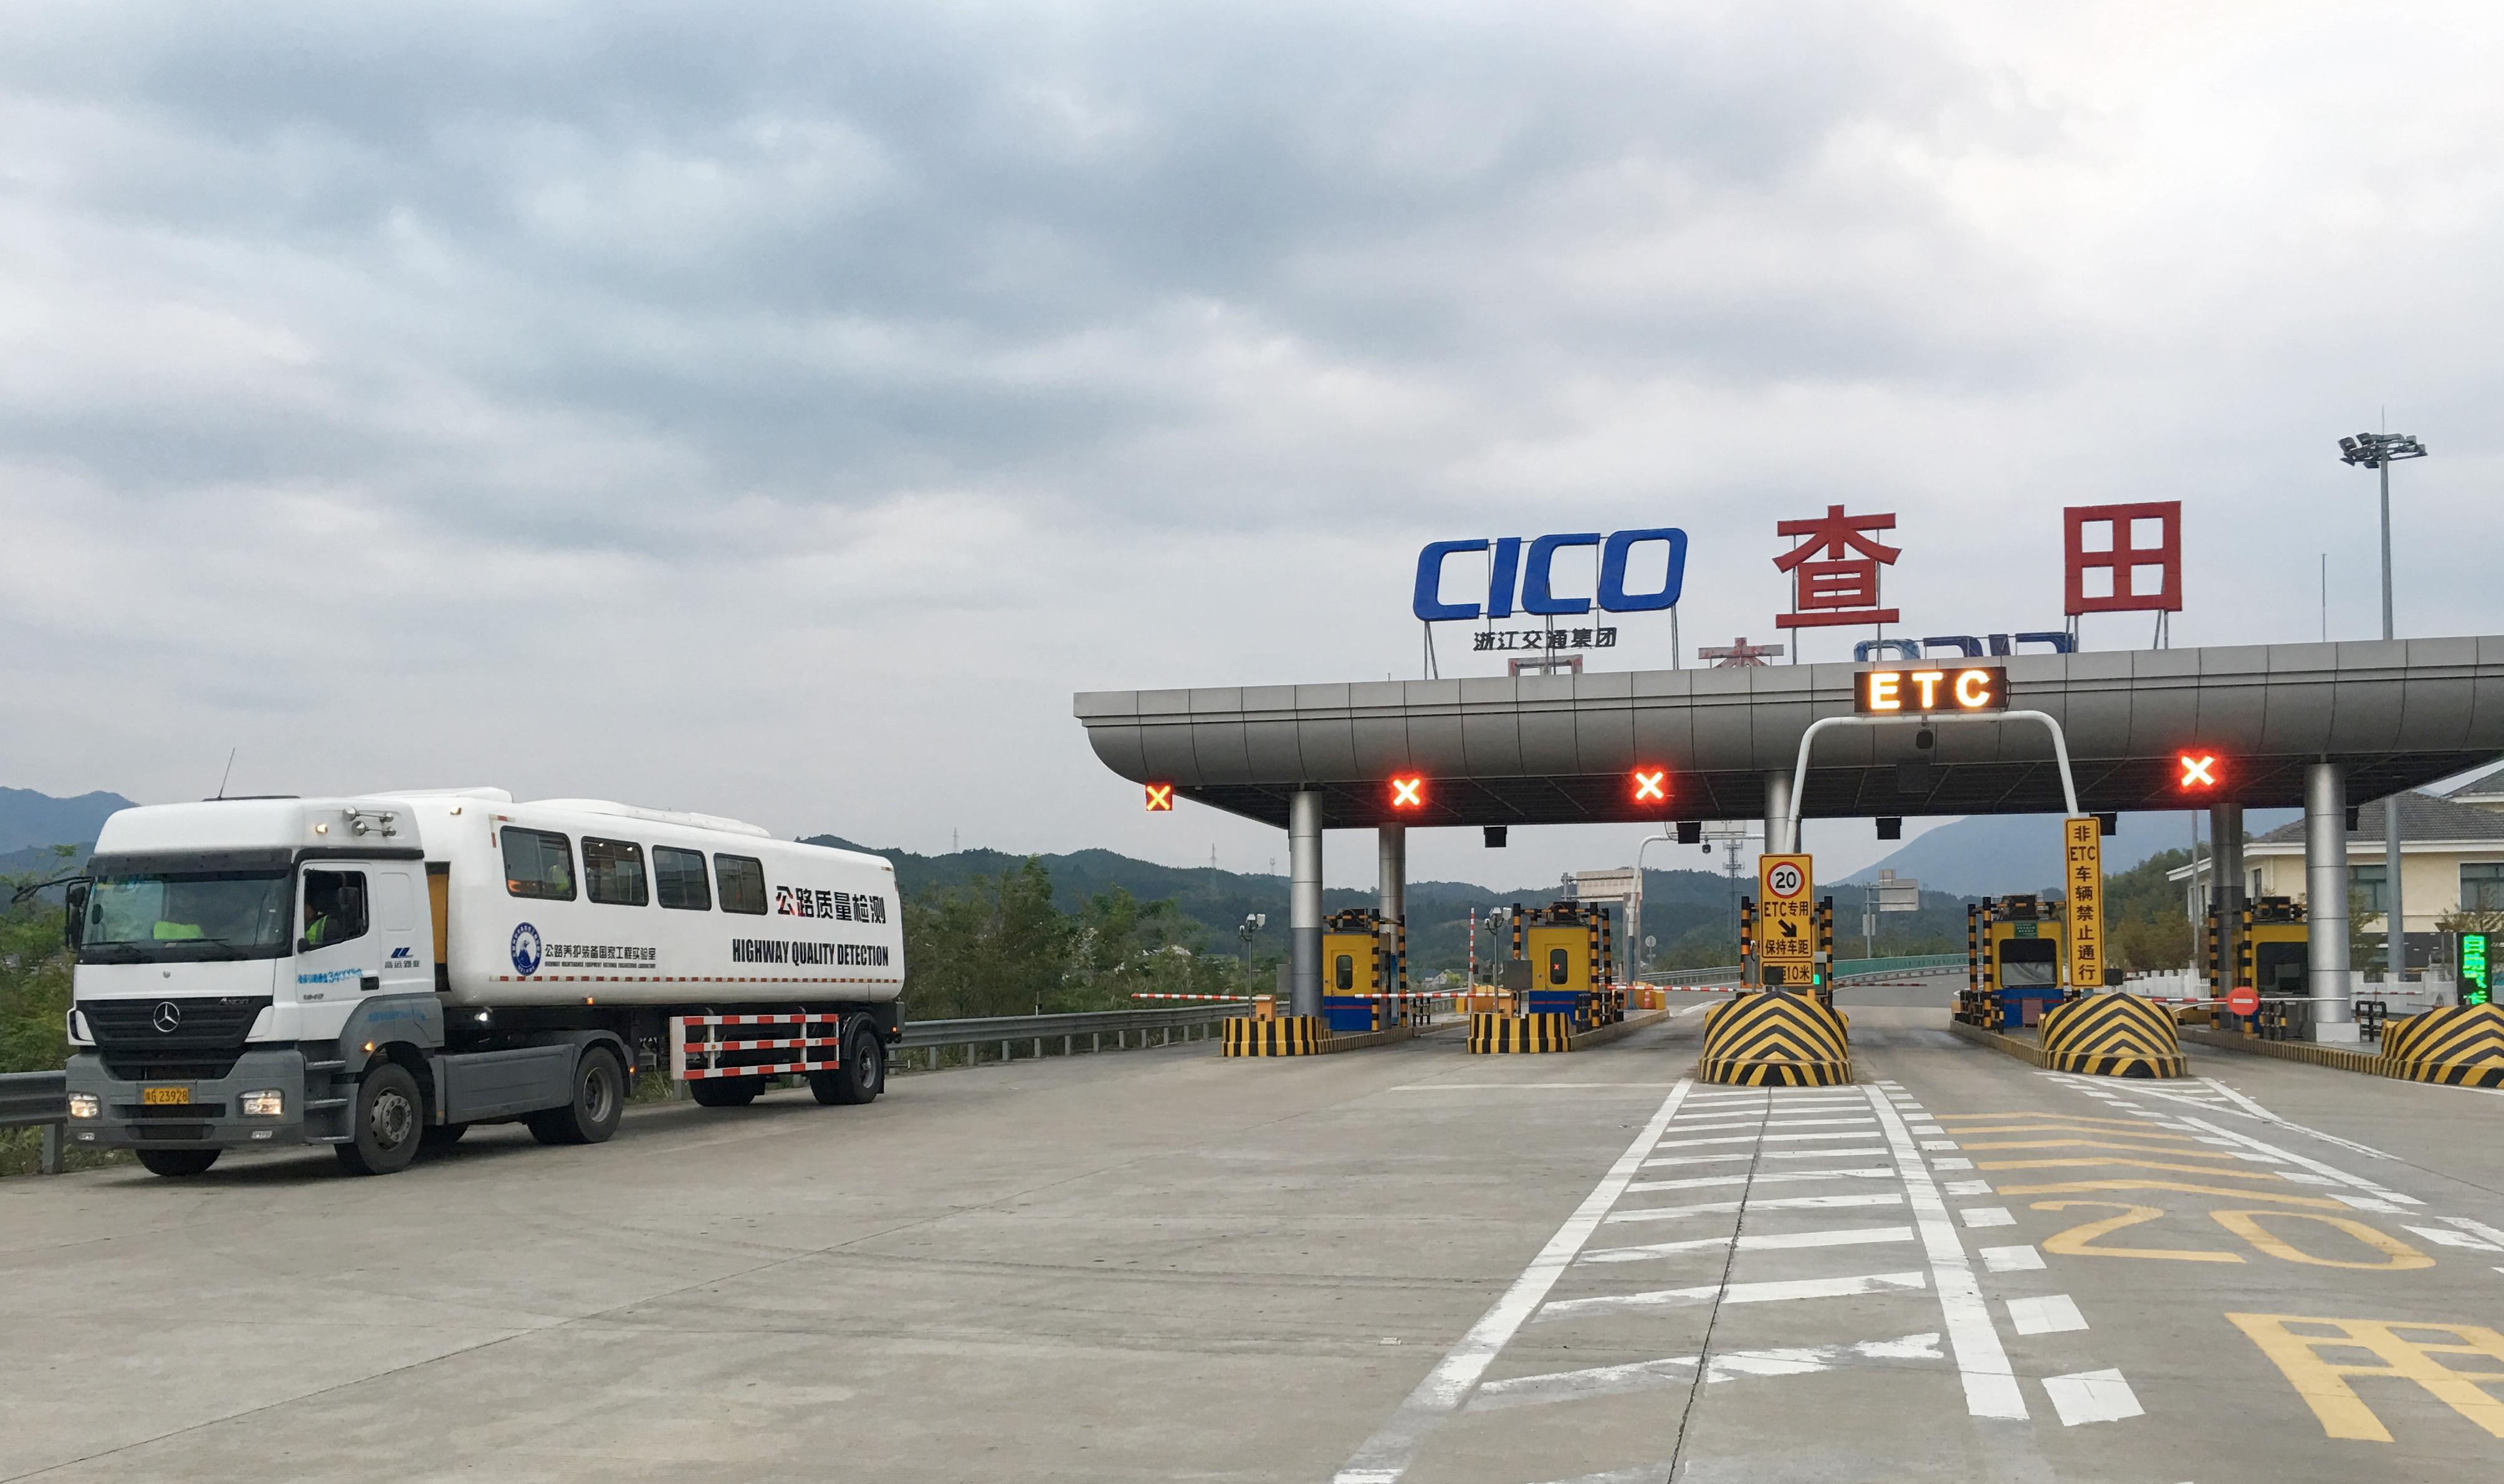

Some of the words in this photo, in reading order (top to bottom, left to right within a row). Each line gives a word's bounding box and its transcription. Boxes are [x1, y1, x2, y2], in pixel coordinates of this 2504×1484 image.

[1413, 528, 1688, 621] CICO
[1473, 627, 1617, 651] 浙江交通集团
[1870, 670, 1990, 710] ETC
[1775, 872, 1796, 888] 20
[775, 885, 886, 924] 公路质量检测
[1764, 901, 1809, 917] ETC专用
[2070, 825, 2096, 981] 非ETC车辆禁止通行
[545, 944, 656, 960] 公路养护装备国家工程实验室
[732, 938, 789, 963] HIGHWAY
[792, 941, 834, 966] QUALITY
[838, 943, 889, 966] DETECTION
[1765, 939, 1809, 954] 保持车距
[1767, 965, 1810, 981] 10米
[2030, 1201, 2436, 1270] 20
